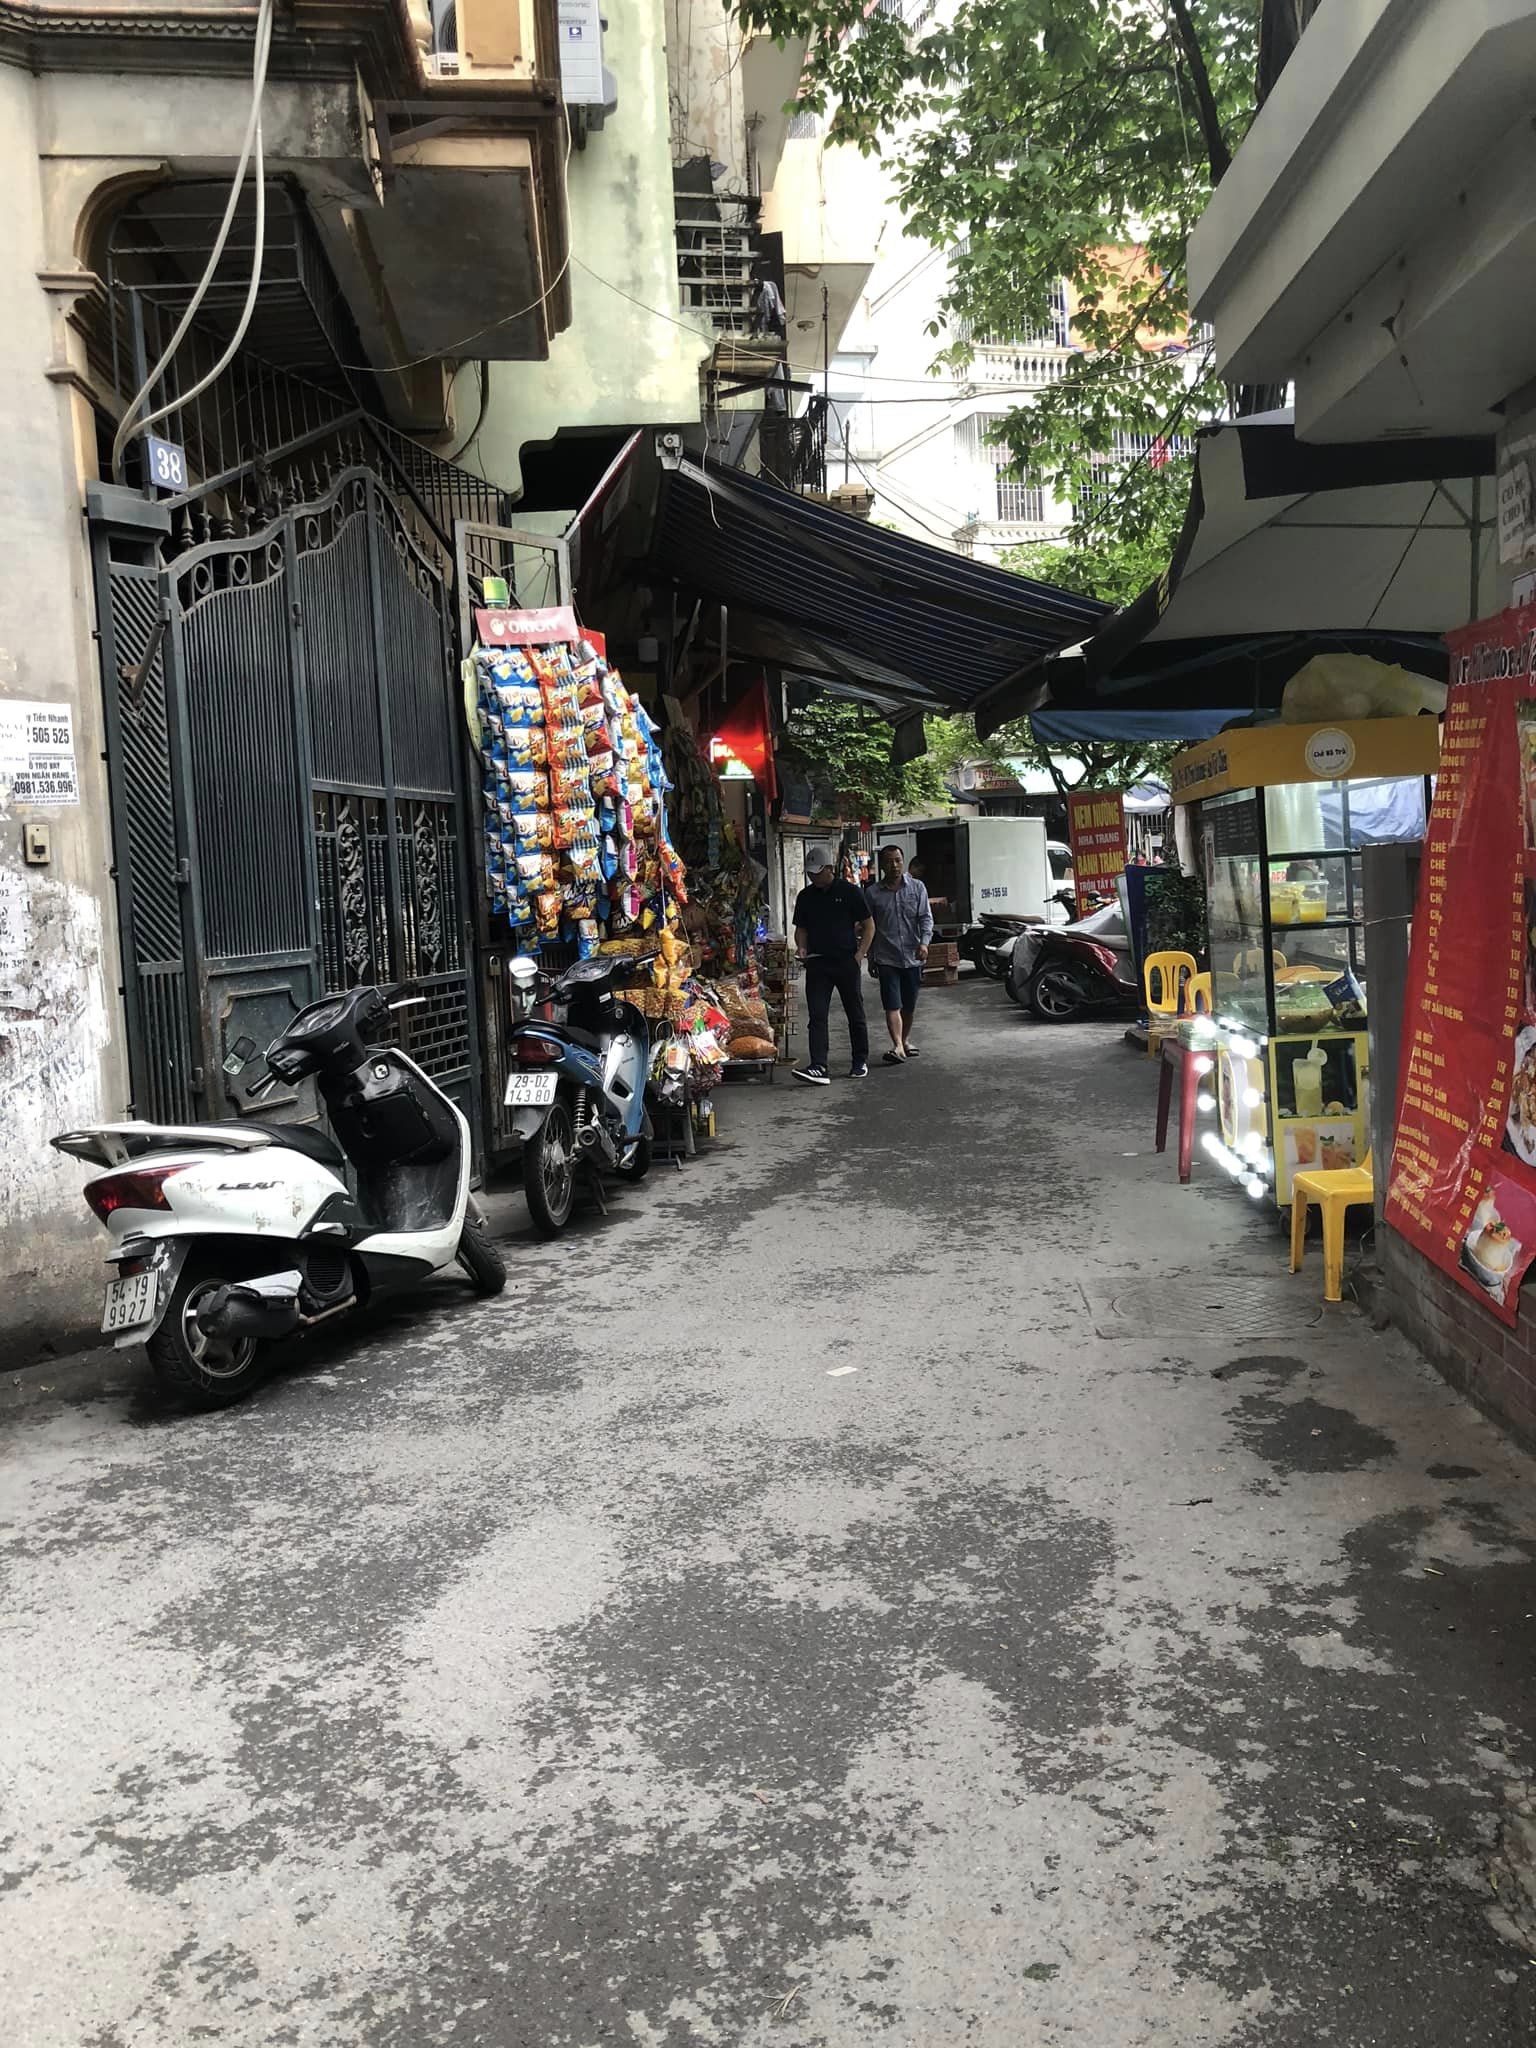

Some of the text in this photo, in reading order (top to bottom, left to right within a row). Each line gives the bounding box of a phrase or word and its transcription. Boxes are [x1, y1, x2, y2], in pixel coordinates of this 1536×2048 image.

[157, 447, 182, 484] 38
[32, 727, 50, 744] 505
[52, 728, 70, 745] 525
[15, 779, 73, 794] 0981.536.996
[1078, 832, 1120, 848] NHA TRANG
[109, 1298, 147, 1327] 9927
